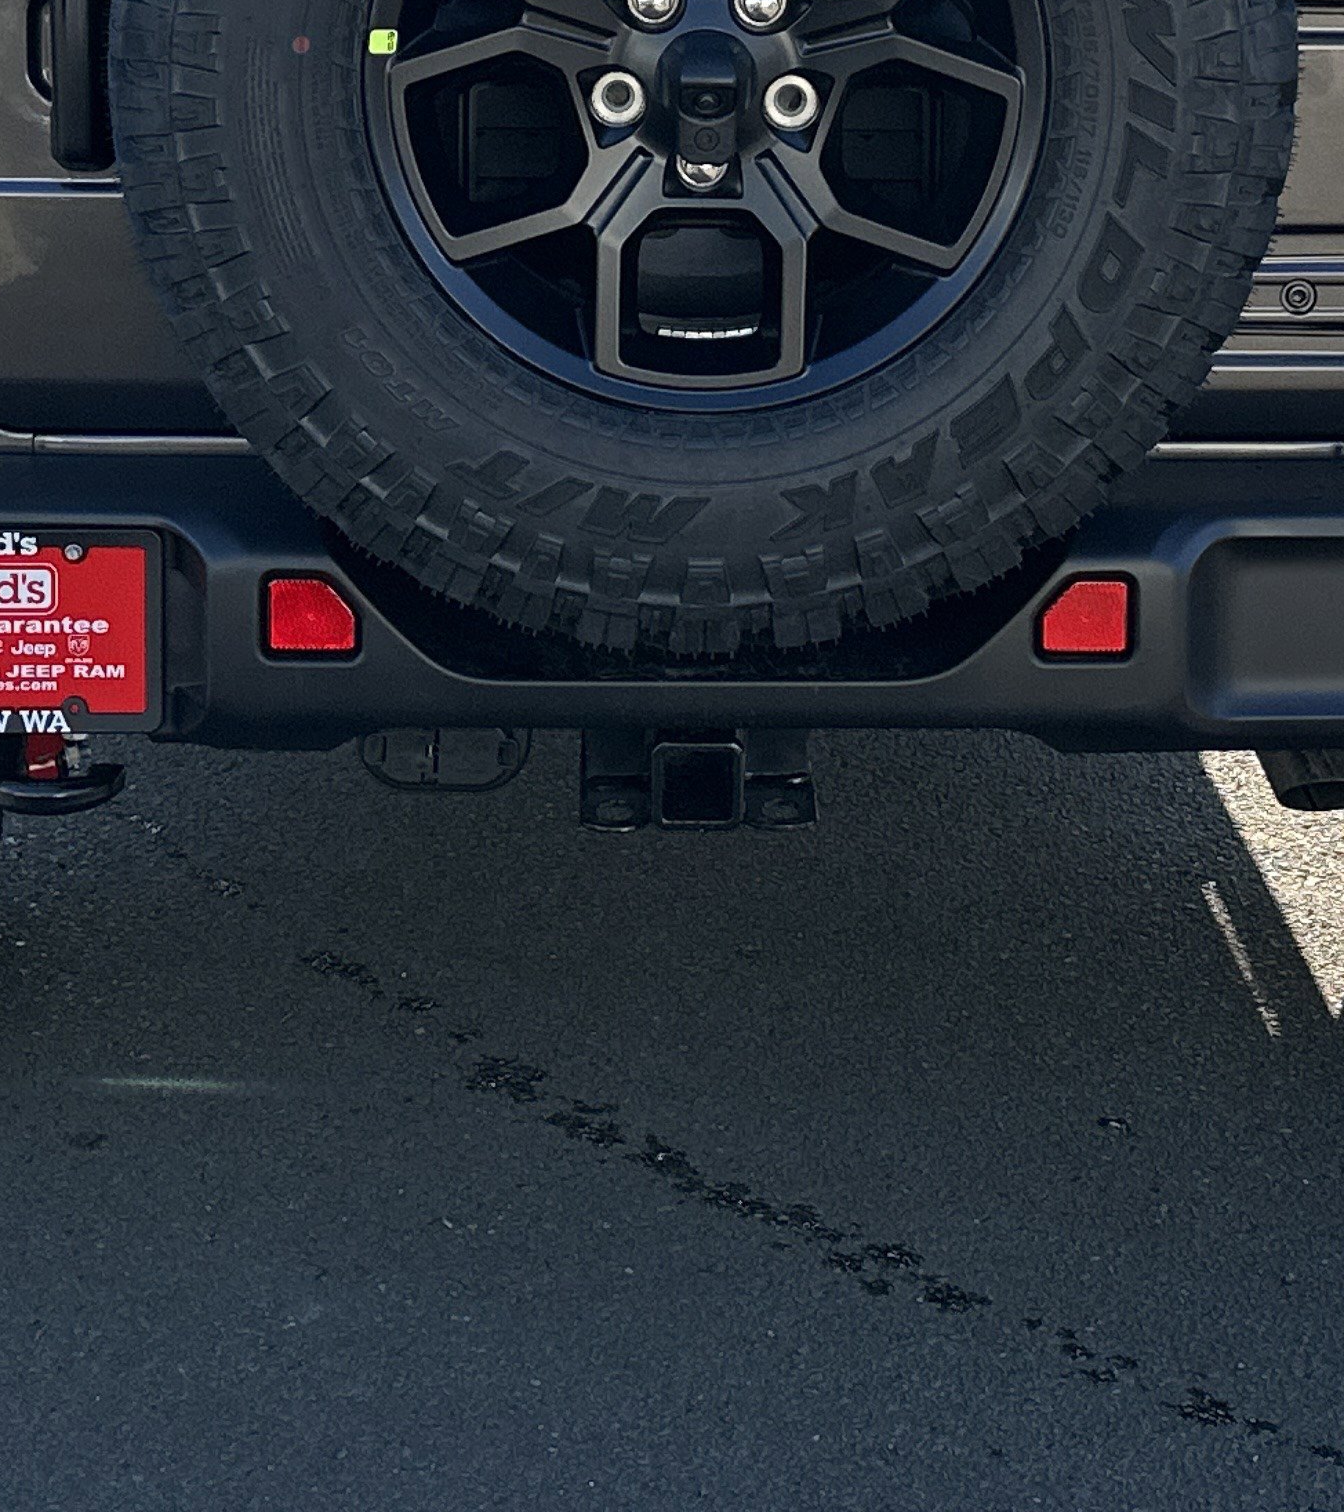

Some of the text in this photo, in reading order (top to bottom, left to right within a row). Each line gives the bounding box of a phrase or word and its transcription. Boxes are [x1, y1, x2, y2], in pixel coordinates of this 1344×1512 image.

[443, 449, 712, 545] M/T
[10, 639, 56, 658] Jeep
[5, 664, 66, 678] JEEP
[72, 664, 126, 678] RAM
[18, 710, 71, 734] WA
